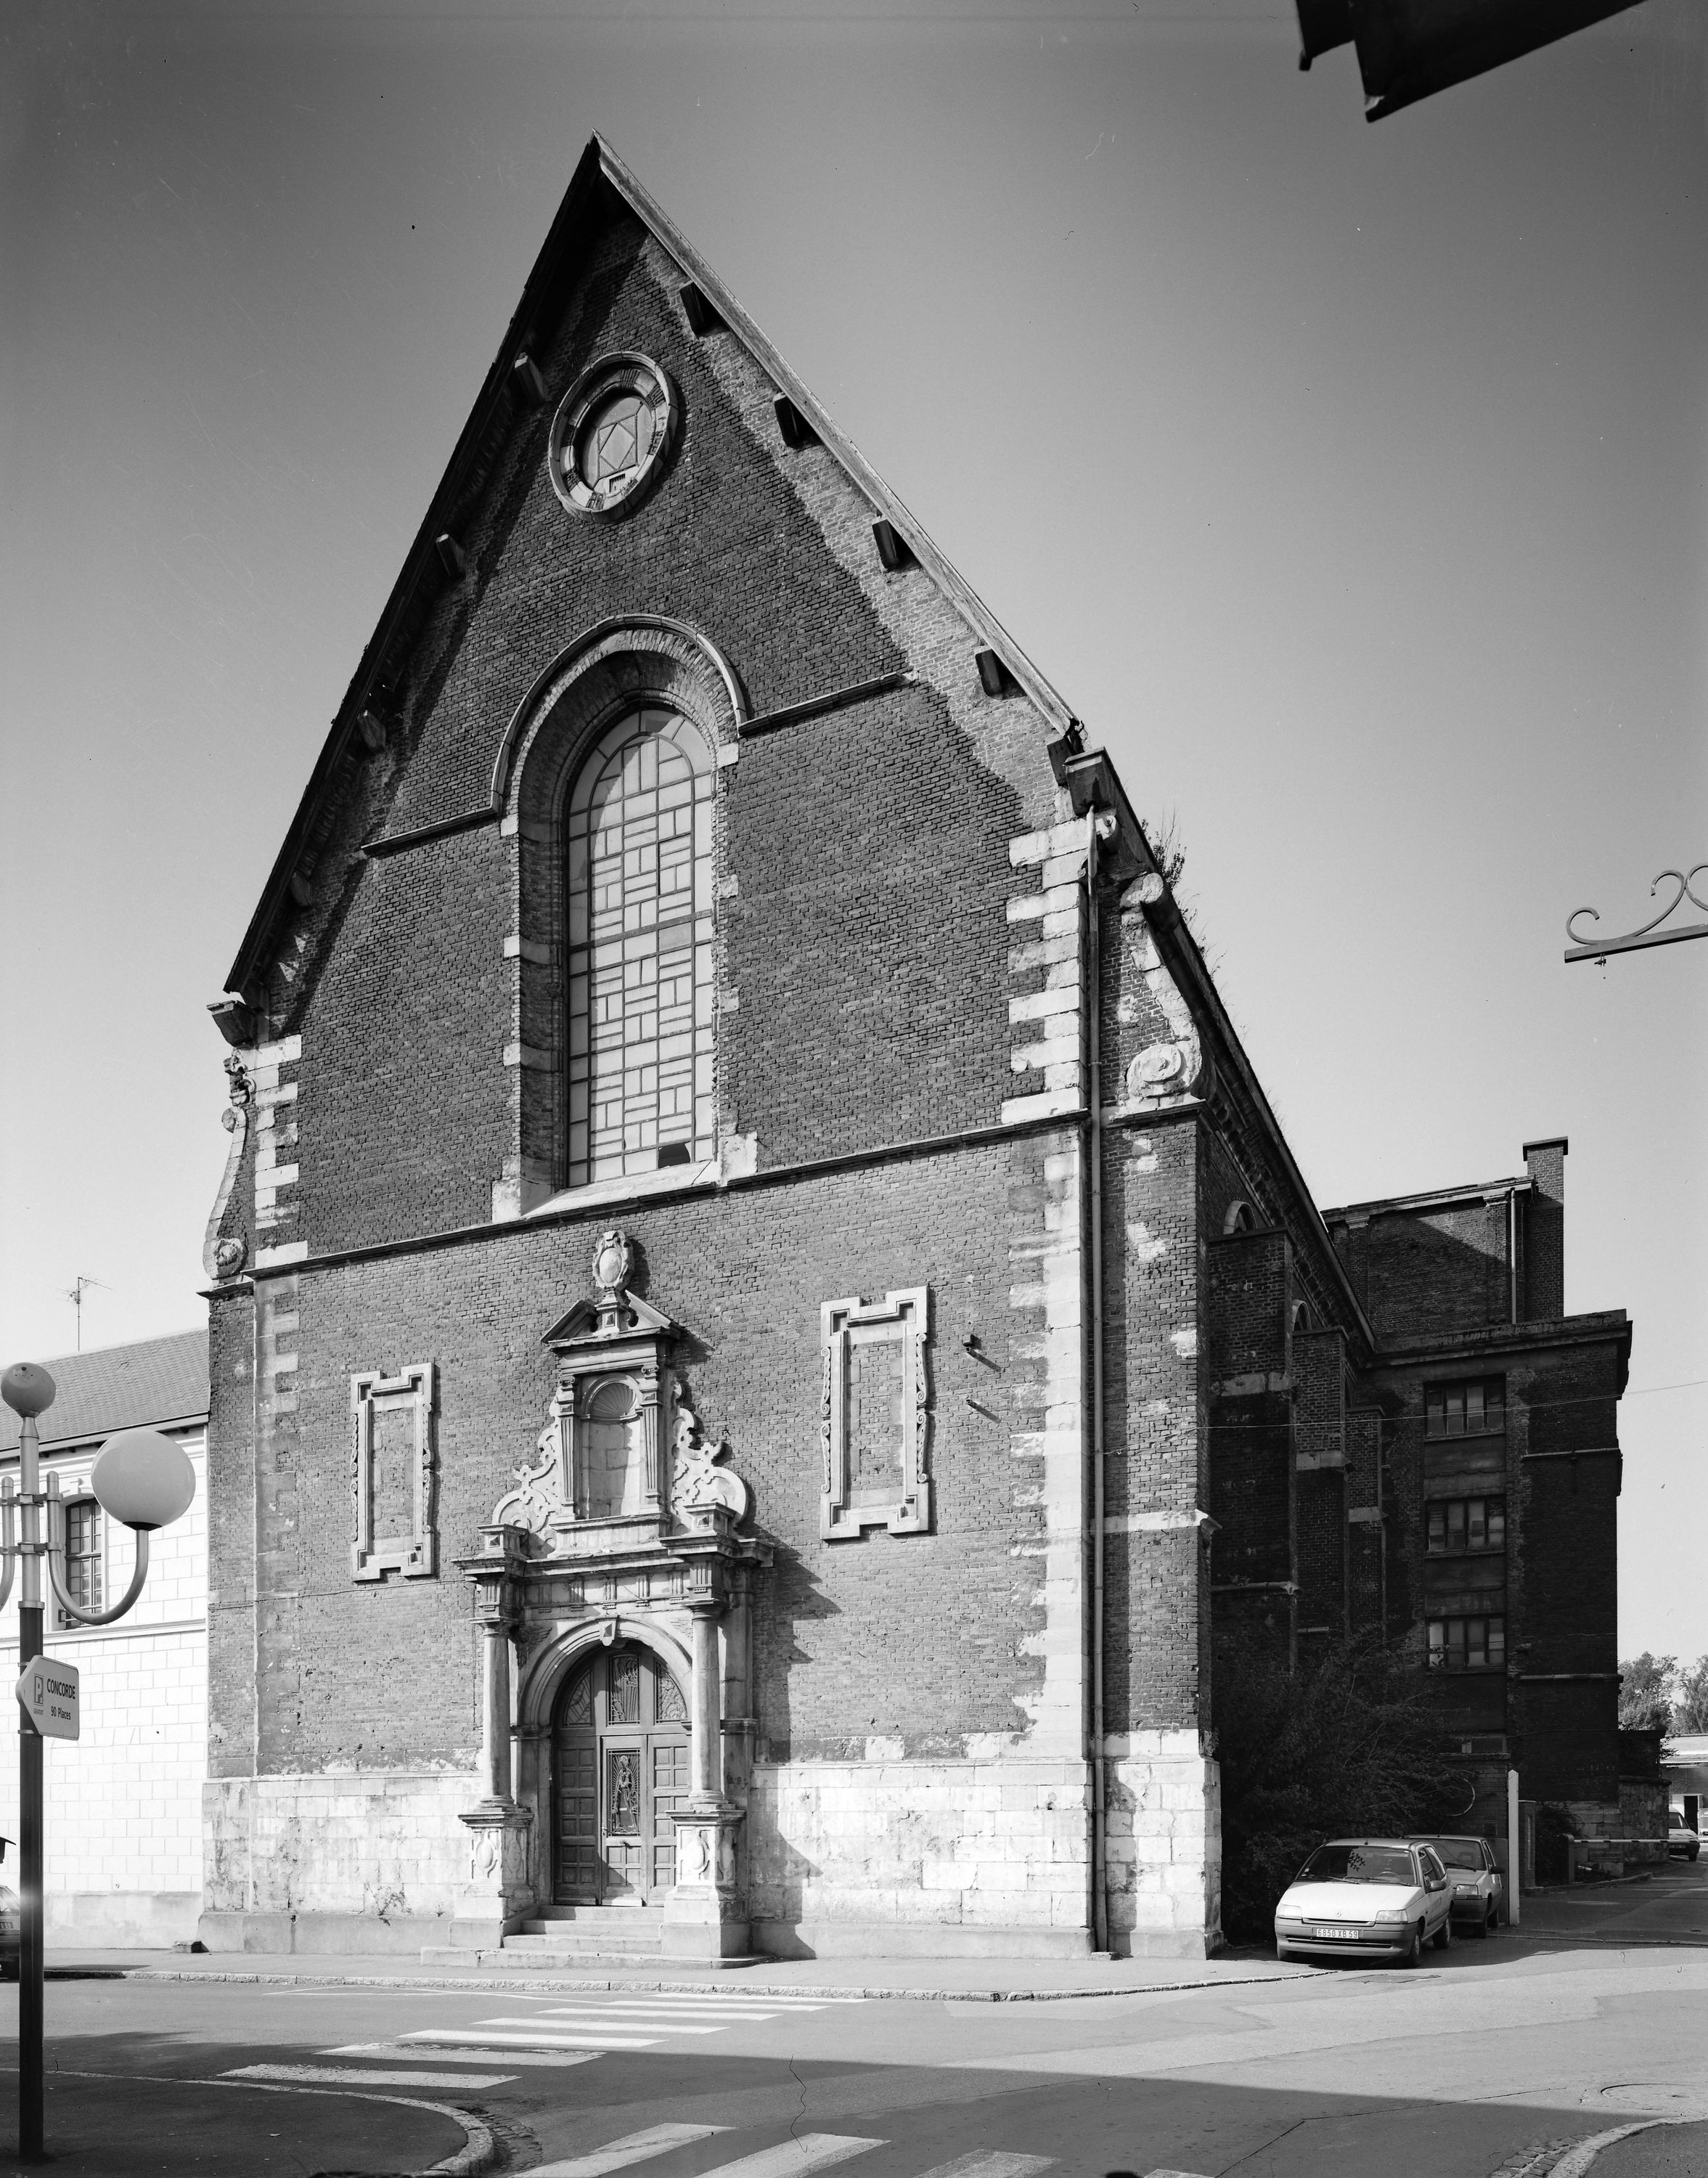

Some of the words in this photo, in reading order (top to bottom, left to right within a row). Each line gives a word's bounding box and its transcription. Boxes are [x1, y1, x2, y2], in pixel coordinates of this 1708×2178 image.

[47, 1678, 75, 1700] CONCORDE
[51, 1706, 56, 1716] 90
[58, 1708, 71, 1720] Places
